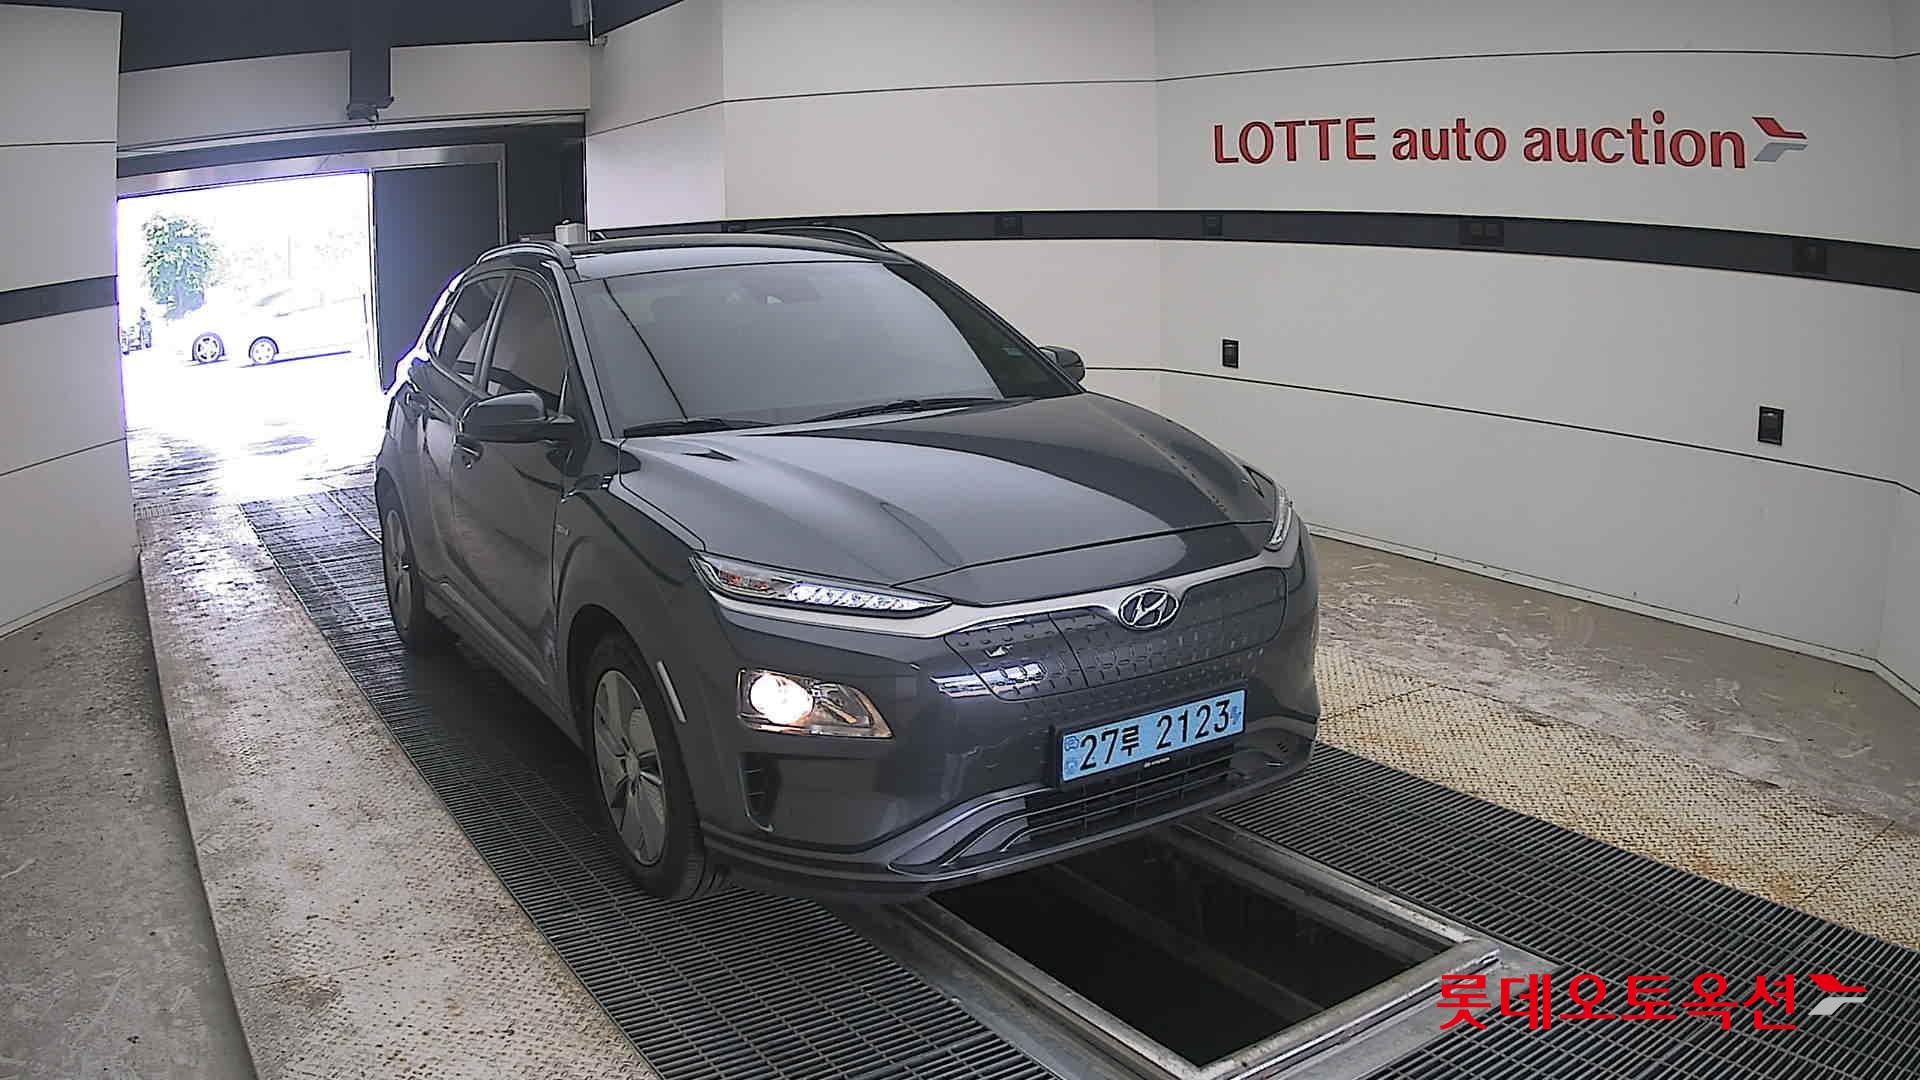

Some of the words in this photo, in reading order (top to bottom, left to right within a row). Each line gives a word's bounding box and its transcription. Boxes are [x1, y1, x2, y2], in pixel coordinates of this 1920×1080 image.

[1213, 117, 1377, 164] LOTTE
[1392, 118, 1508, 163] auto
[1523, 111, 1747, 169] auction
[1079, 724, 1140, 771] 27루
[1156, 699, 1231, 751] 2123
